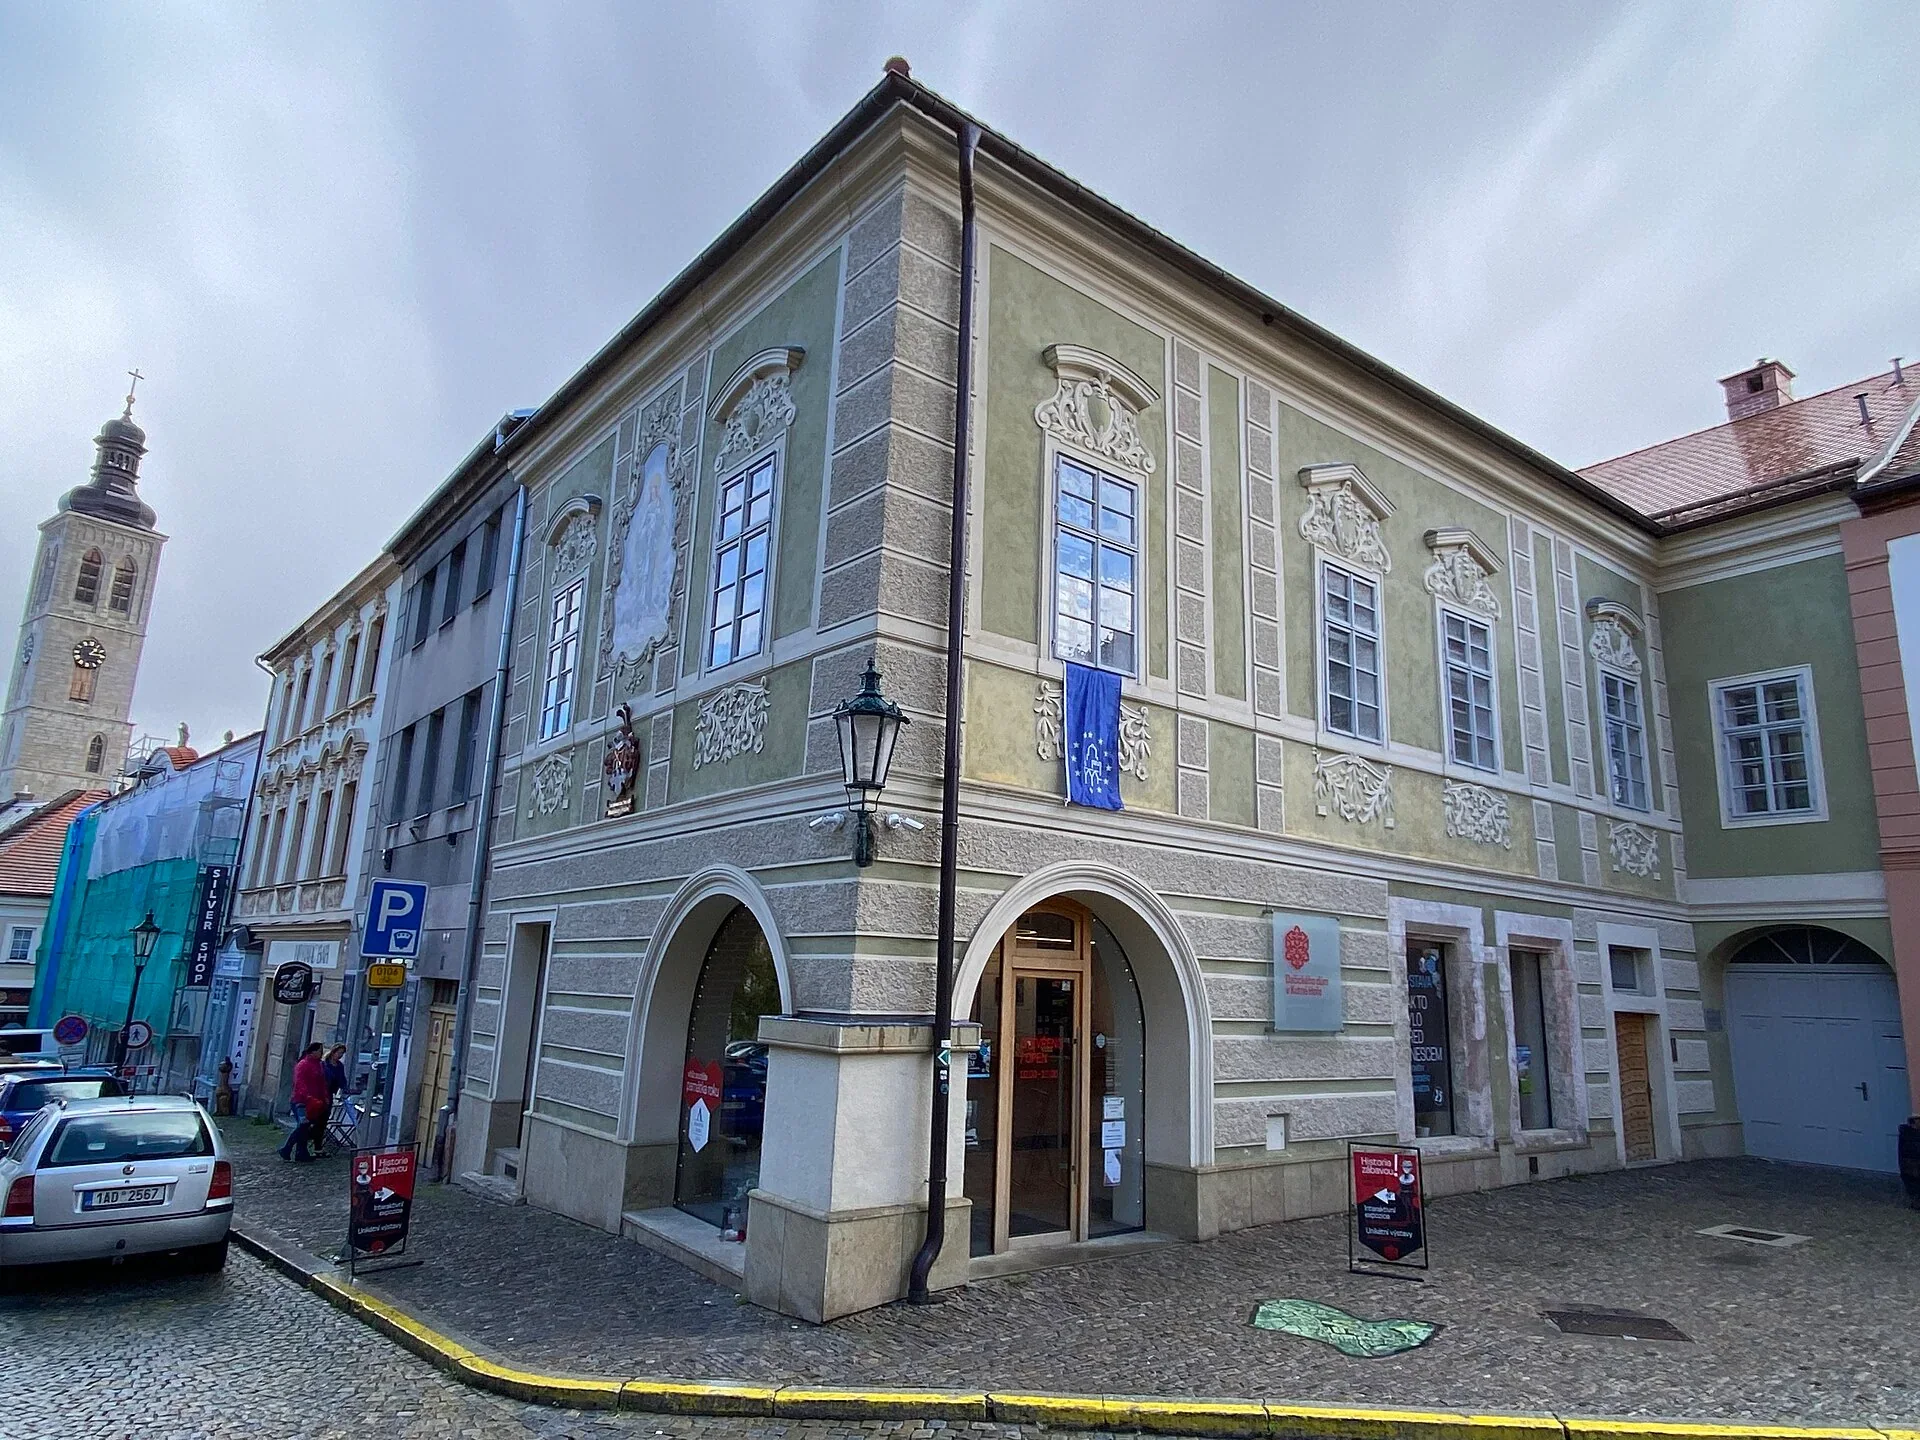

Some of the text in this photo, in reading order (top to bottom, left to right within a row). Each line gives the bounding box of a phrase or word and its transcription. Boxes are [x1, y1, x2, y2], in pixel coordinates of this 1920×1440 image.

[377, 889, 414, 932] P
[194, 869, 221, 983] SILVER SHOP
[1409, 974, 1433, 988] STAVA
[1361, 1157, 1391, 1166] Historie
[96, 1188, 159, 1204] 1AD 2567
